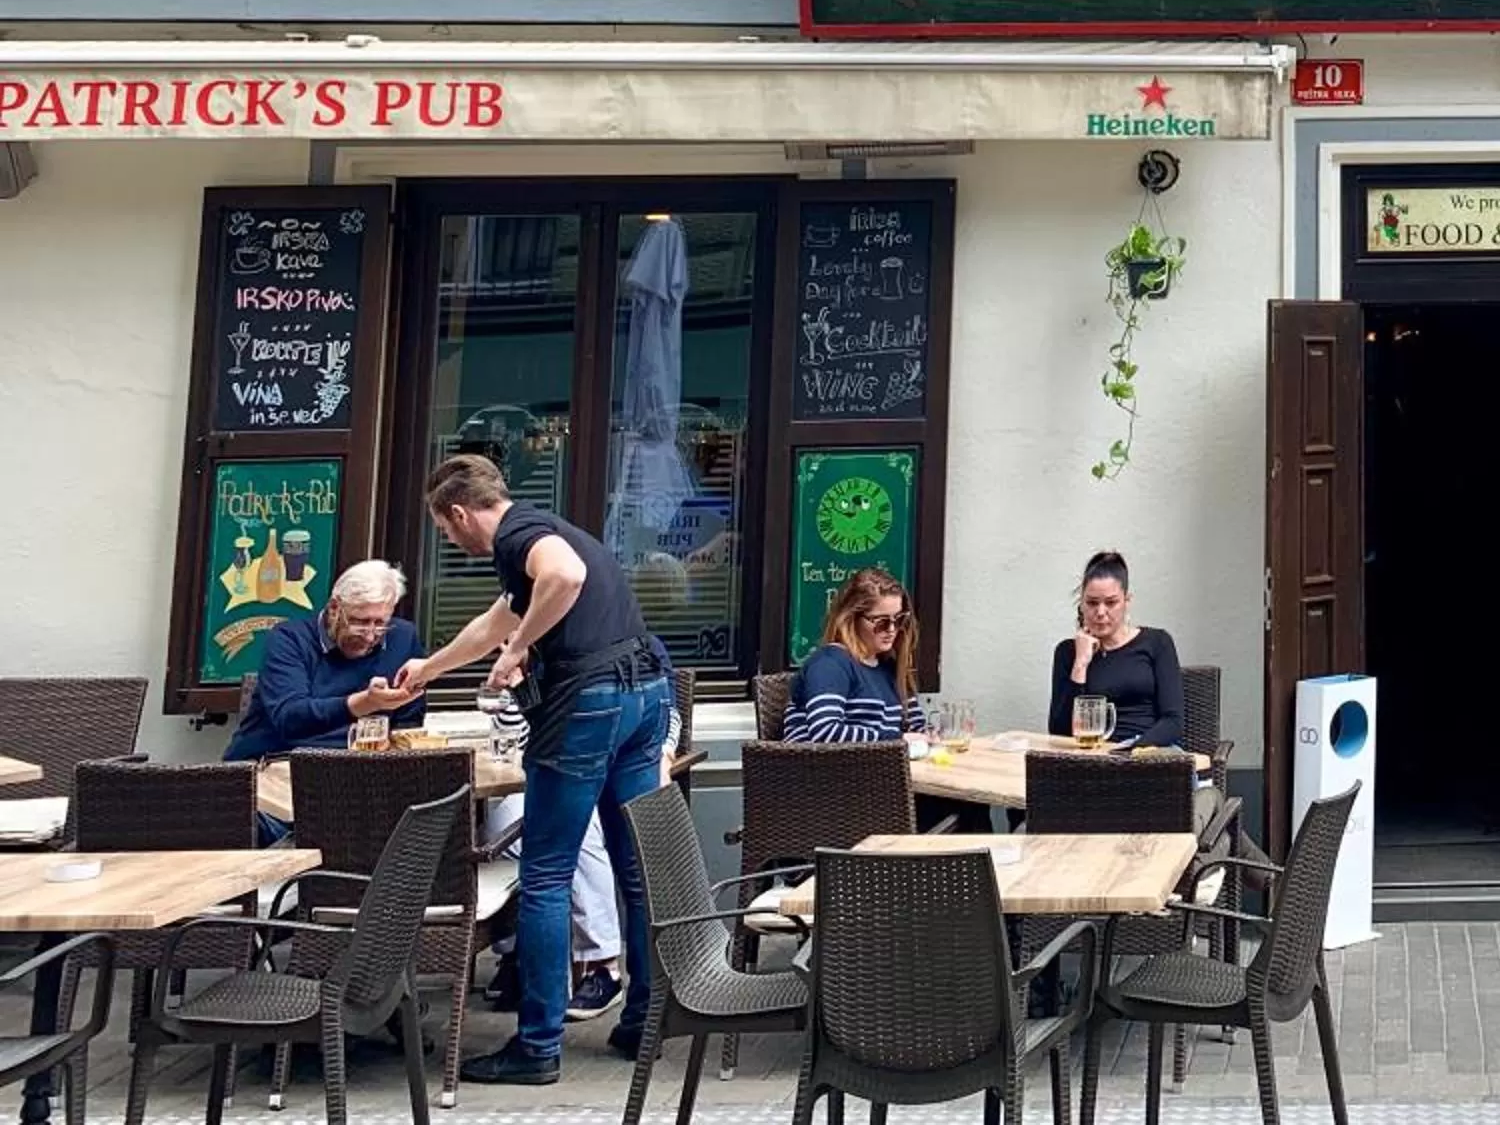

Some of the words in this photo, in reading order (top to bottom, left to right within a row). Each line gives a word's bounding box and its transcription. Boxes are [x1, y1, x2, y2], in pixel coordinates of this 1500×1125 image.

[1314, 64, 1343, 88] 10
[0, 79, 347, 128] PATRICK'S
[375, 80, 502, 128] PUB
[1086, 113, 1215, 136] Heineken
[1450, 193, 1475, 209] We
[1404, 223, 1483, 246] FOOD
[236, 287, 303, 312] IRSKO
